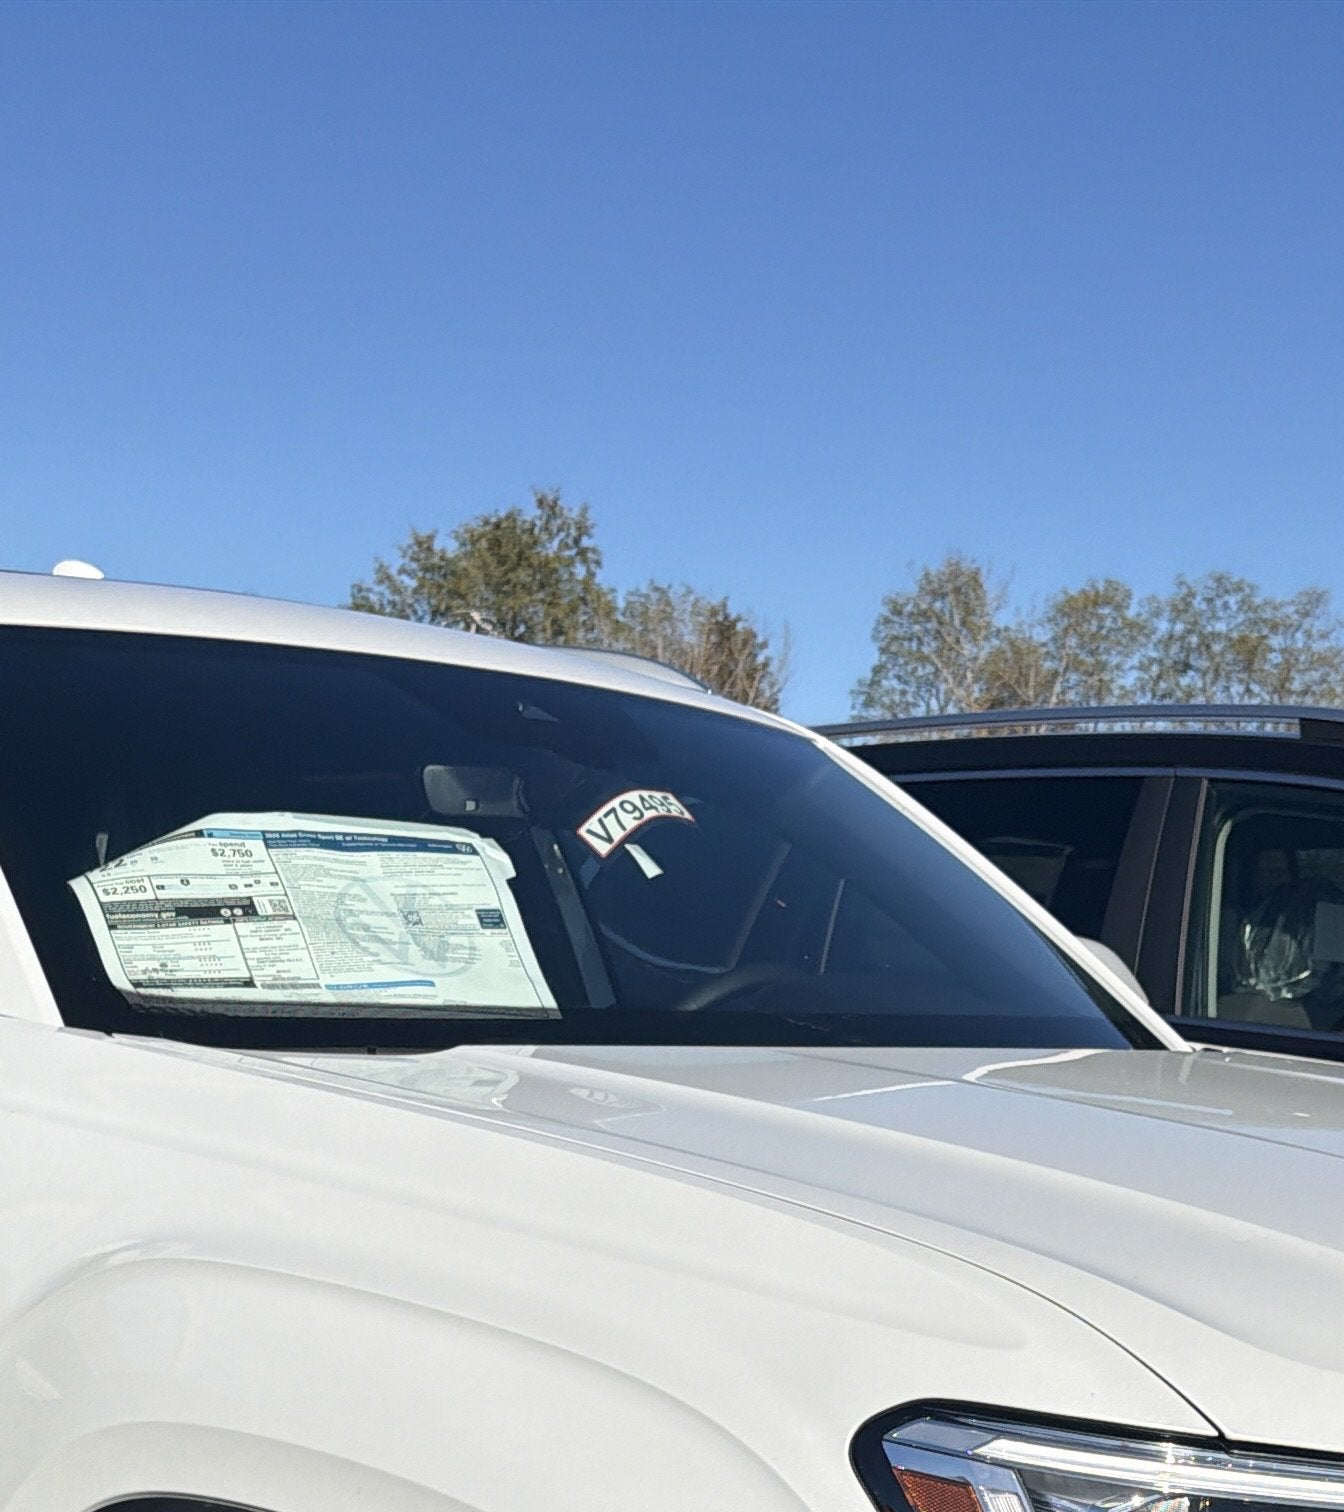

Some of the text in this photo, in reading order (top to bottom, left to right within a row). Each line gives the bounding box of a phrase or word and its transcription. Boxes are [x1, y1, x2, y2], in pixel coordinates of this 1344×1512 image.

[585, 793, 685, 845] V79495
[210, 847, 253, 858] $2,750
[101, 884, 147, 896] $2,250
